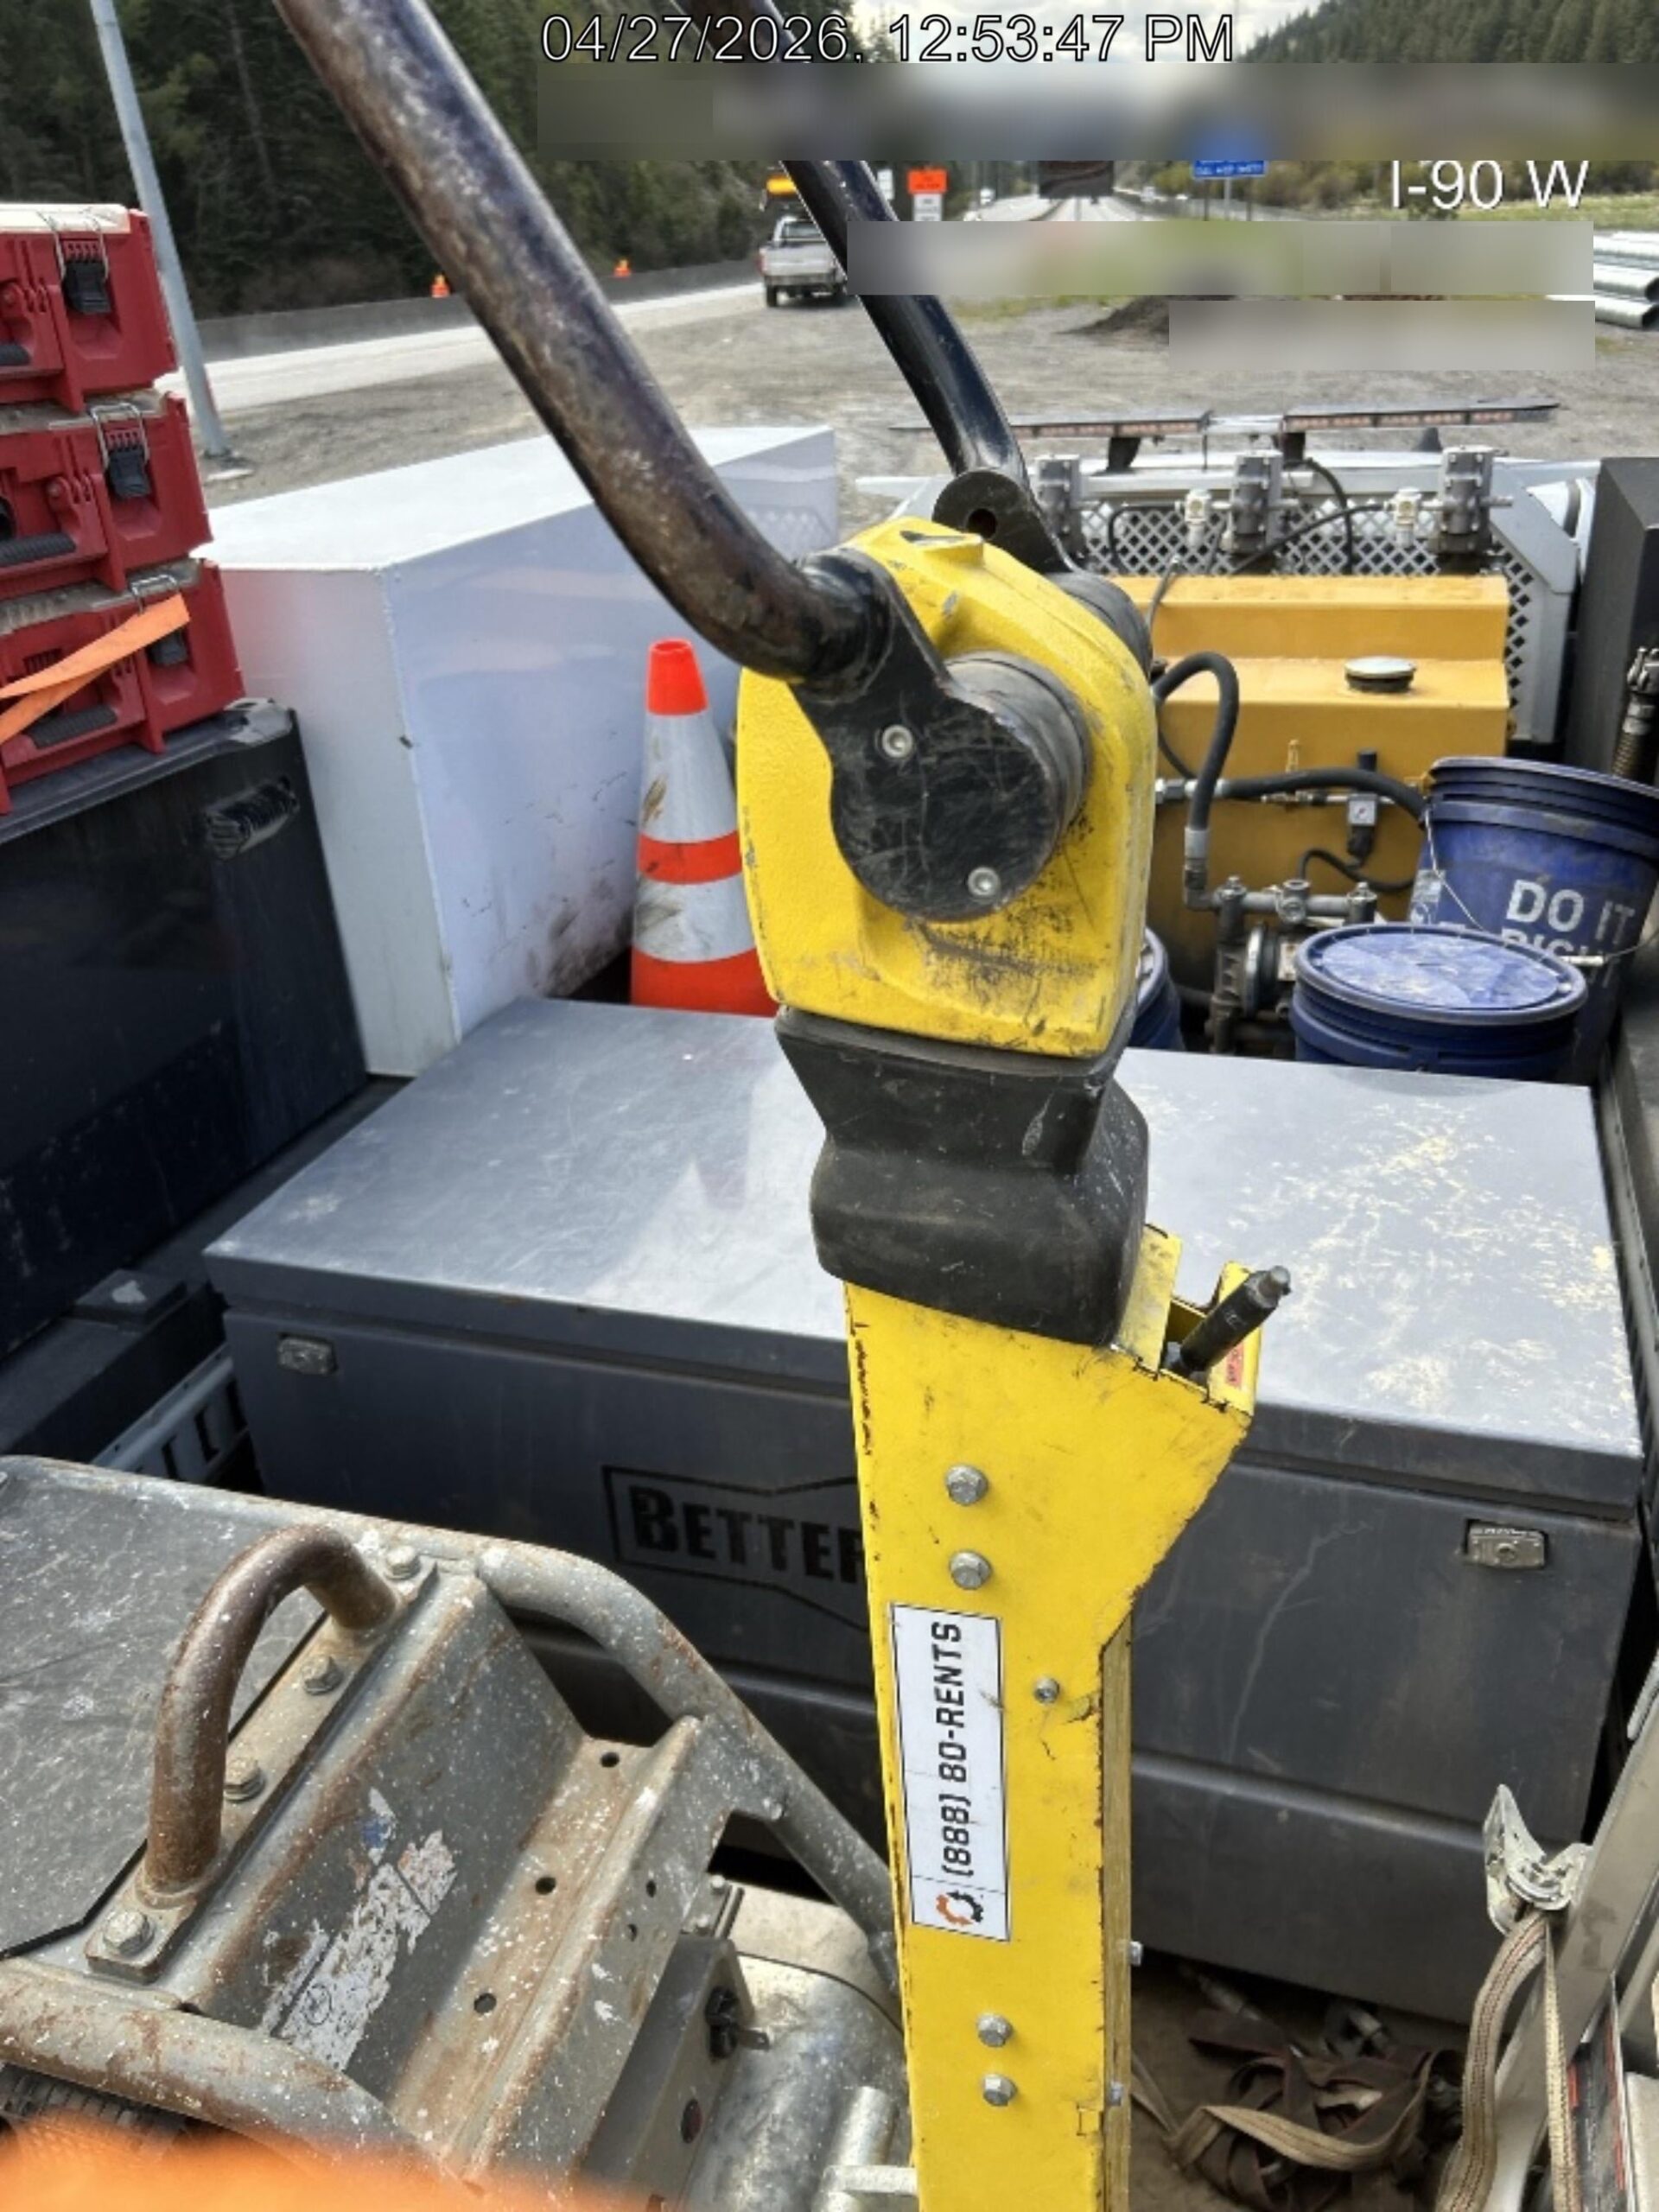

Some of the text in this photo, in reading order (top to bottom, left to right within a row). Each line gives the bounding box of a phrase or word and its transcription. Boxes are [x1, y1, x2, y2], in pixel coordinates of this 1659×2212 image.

[1506, 880, 1584, 932] DO
[1595, 900, 1636, 945] IT
[931, 1621, 975, 1877] (888) 80-RENTS
